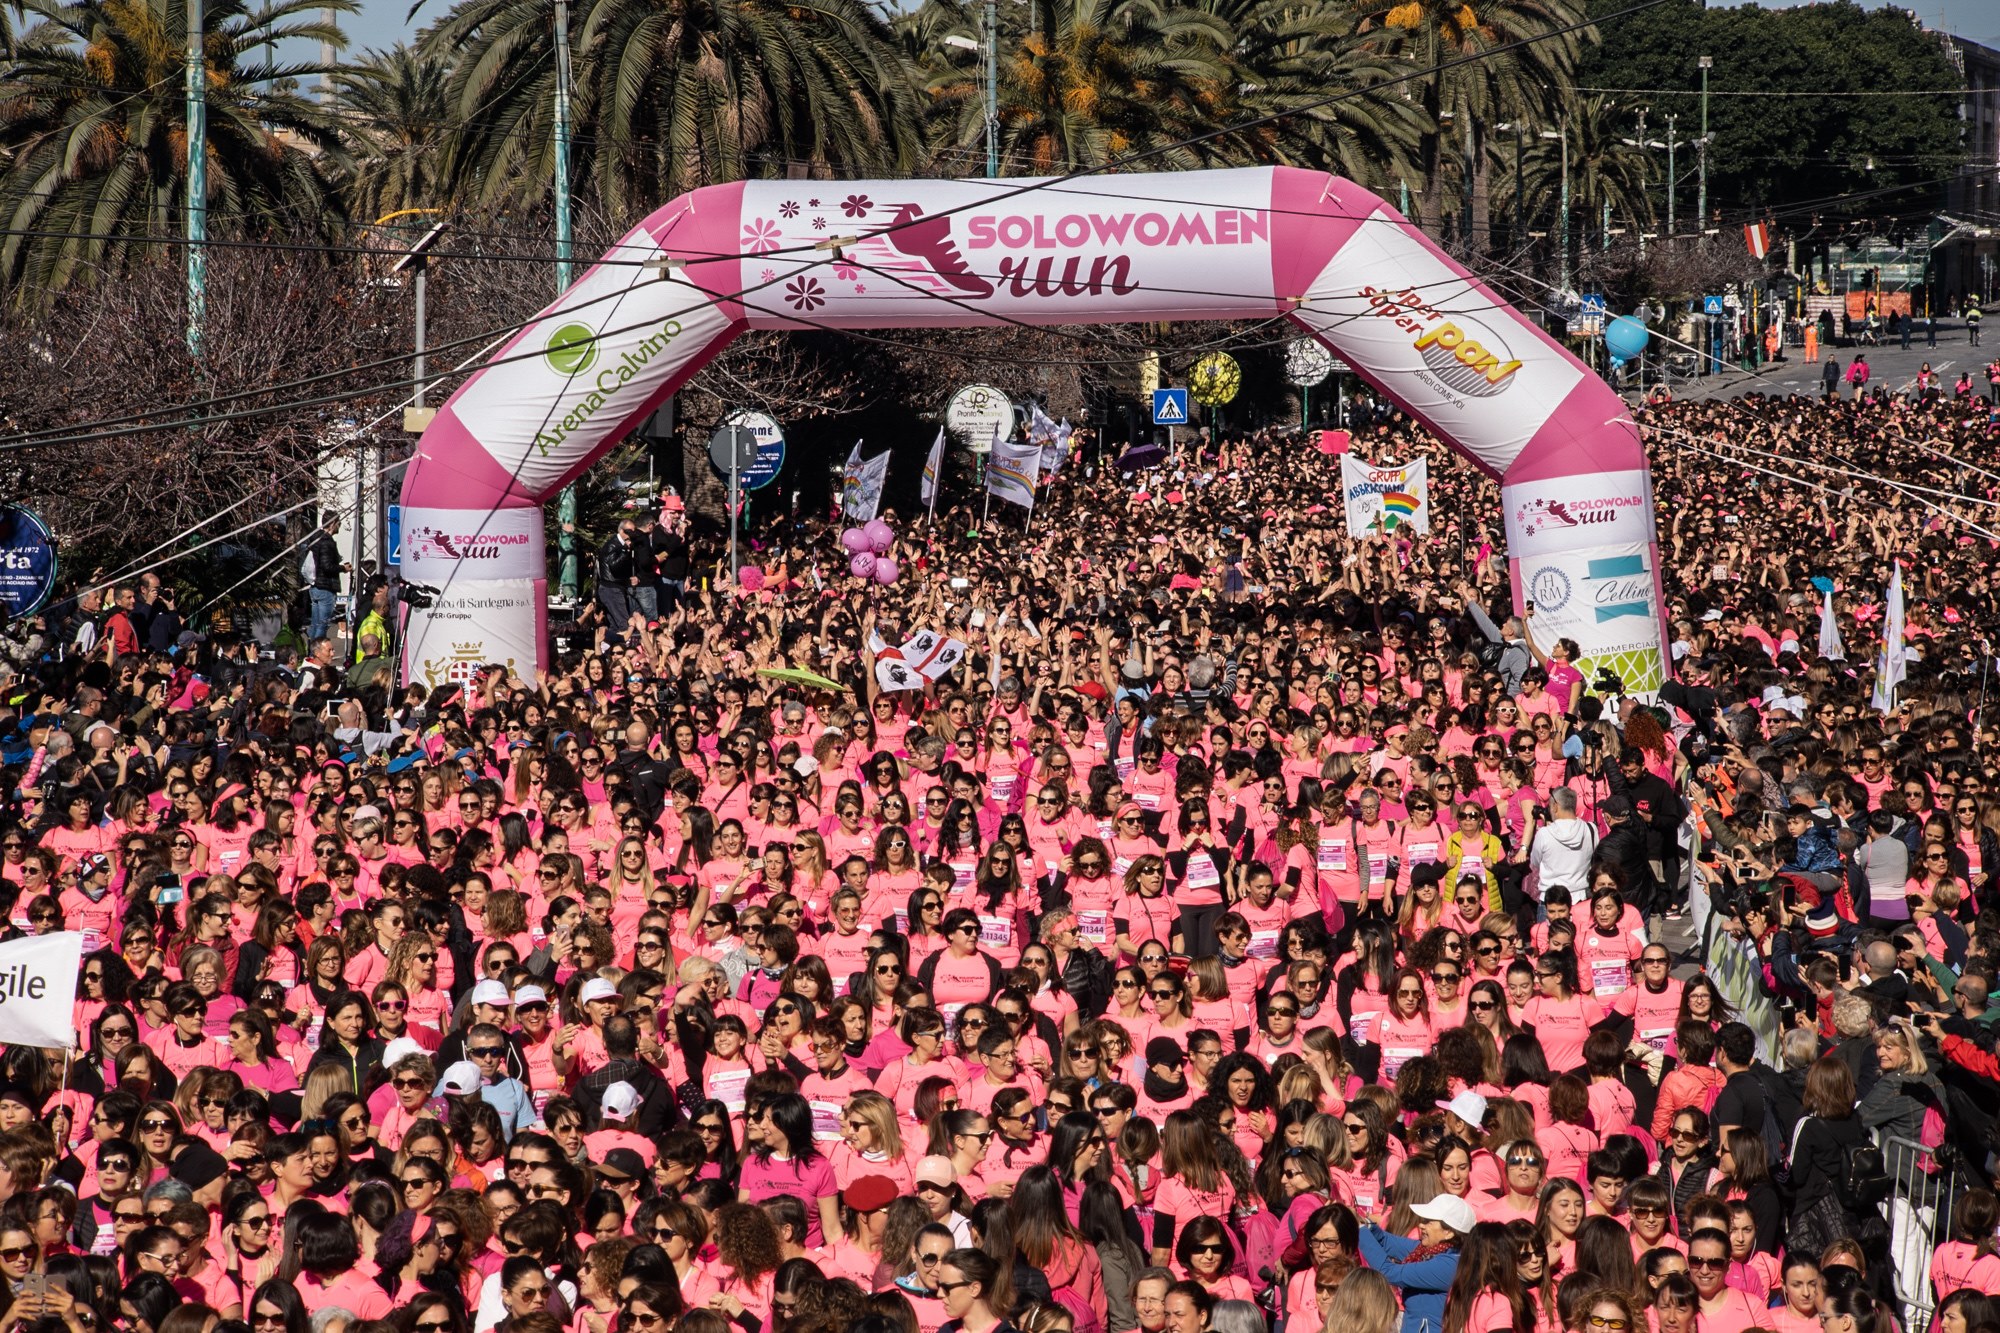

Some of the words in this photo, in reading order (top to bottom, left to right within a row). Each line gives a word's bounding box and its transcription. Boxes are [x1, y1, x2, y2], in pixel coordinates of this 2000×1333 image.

[968, 210, 1269, 249] SOLOWOMEN
[998, 253, 1140, 298] run
[533, 320, 683, 457] ArenaCalvino
[1413, 369, 1434, 387] SARDI
[1433, 383, 1454, 402] COME
[1453, 397, 1466, 410] VOI
[1368, 470, 1406, 482] GRUPPO
[1349, 482, 1405, 501] ABBRACCIAMO
[1569, 496, 1642, 512] SOLOWOMEN
[1578, 508, 1617, 524] run
[454, 534, 529, 545] SOLOWOMEN
[462, 546, 501, 559] run
[430, 599, 455, 609] anco
[456, 599, 466, 609] di
[467, 598, 514, 610] Sardegna
[985, 933, 1008, 941] 11345
[1085, 926, 1104, 934] 11344
